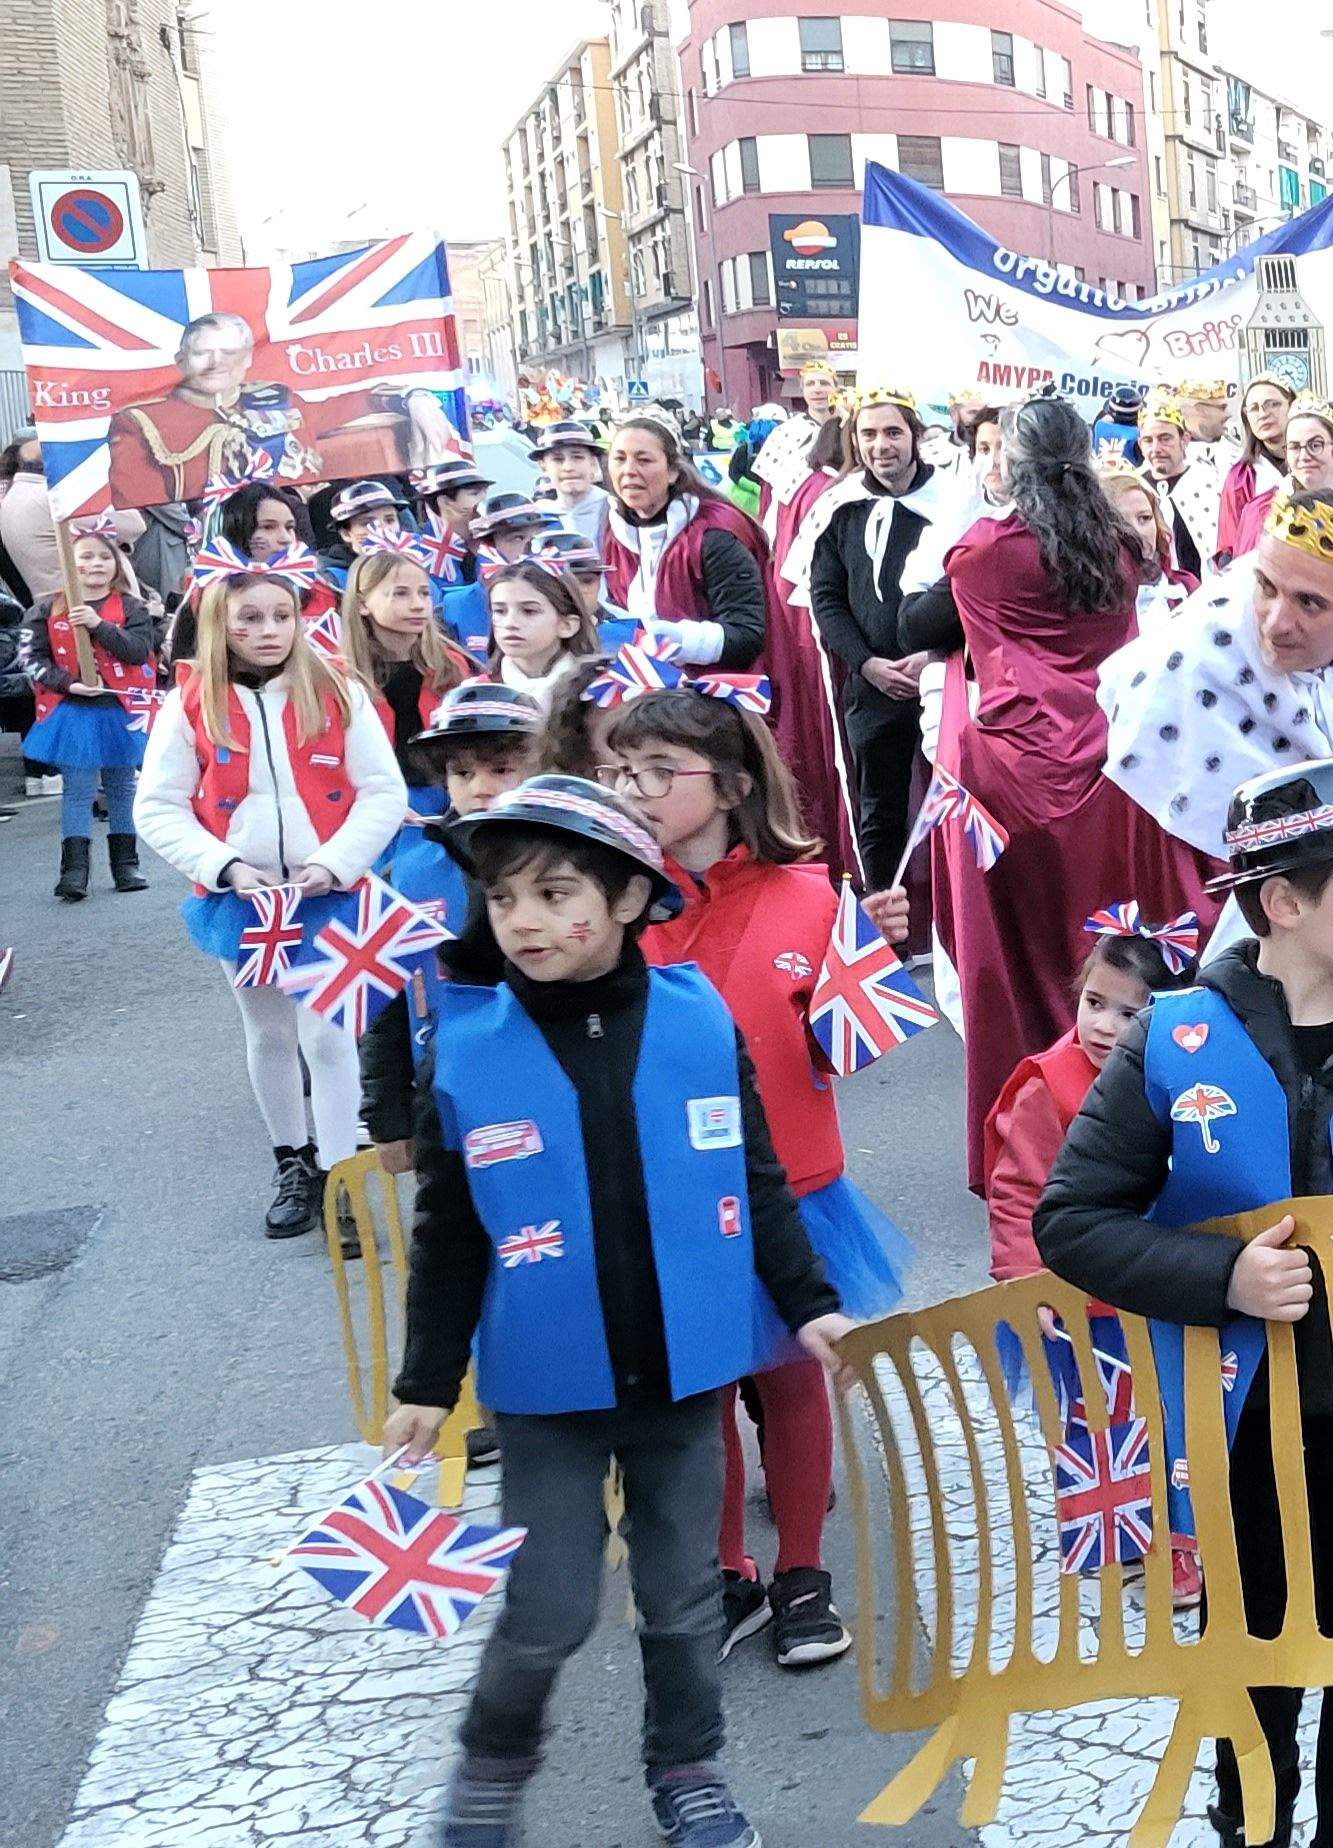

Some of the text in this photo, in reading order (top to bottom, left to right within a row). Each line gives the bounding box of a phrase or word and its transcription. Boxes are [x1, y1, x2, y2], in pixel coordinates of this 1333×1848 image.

[785, 259, 840, 270] REPSOL
[964, 289, 1019, 326] We
[286, 331, 445, 376] Charles III
[33, 380, 111, 410] King
